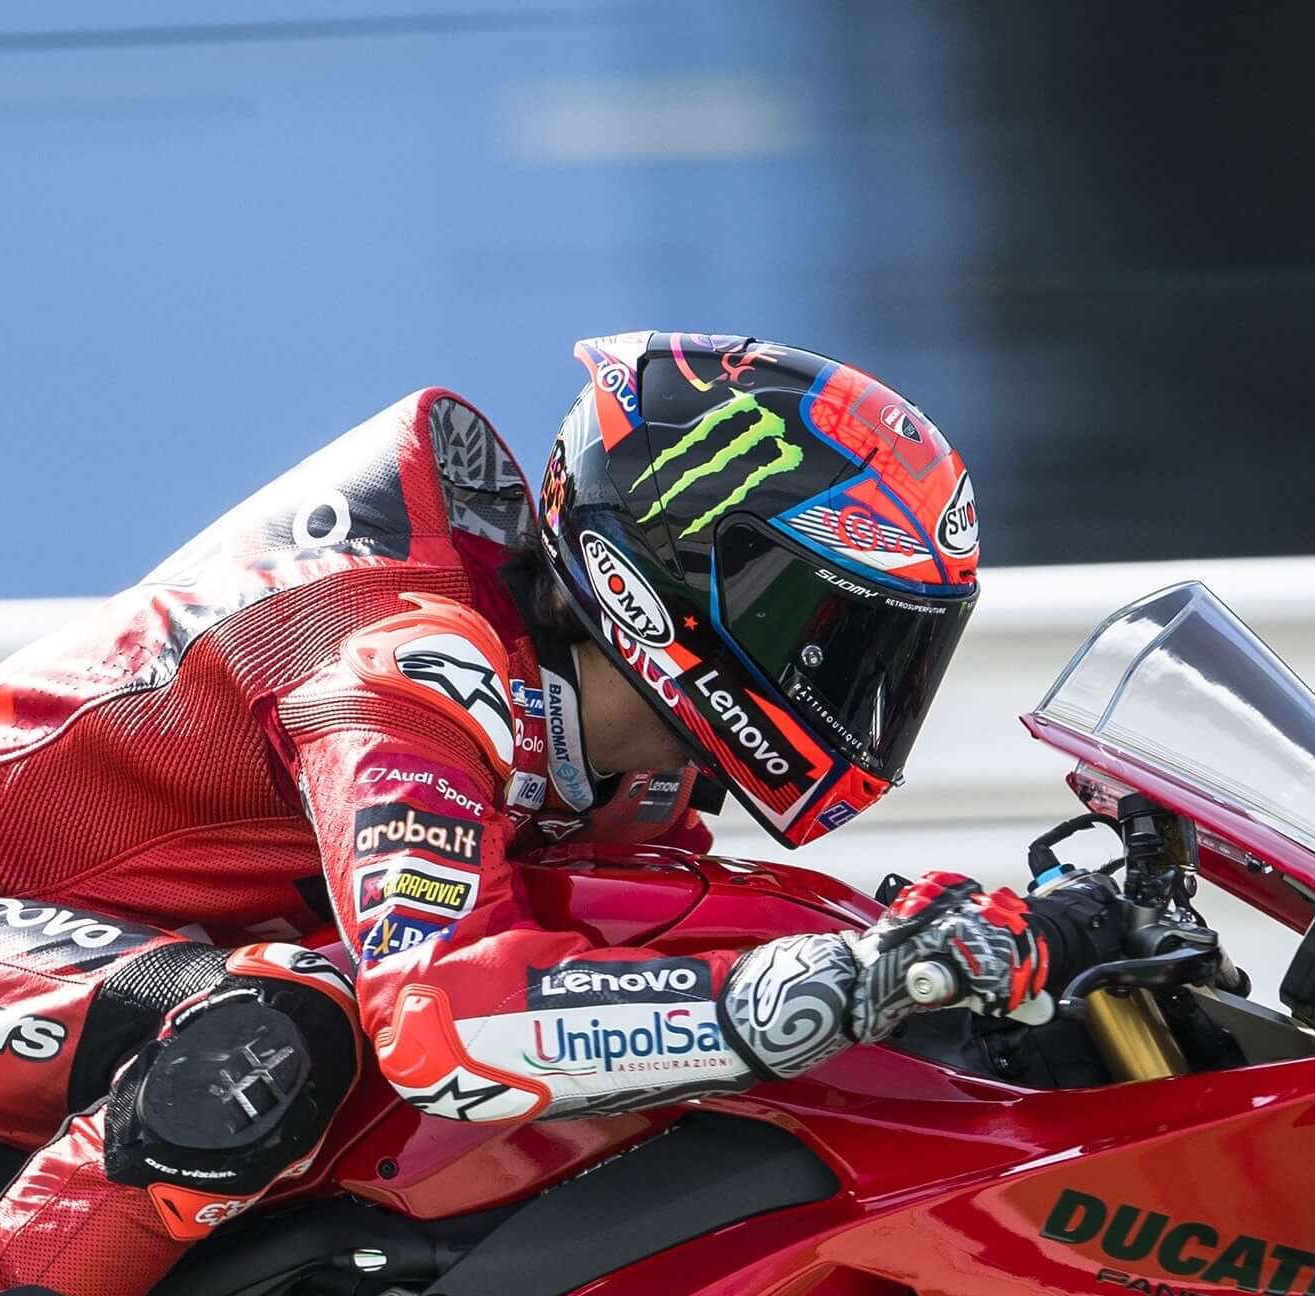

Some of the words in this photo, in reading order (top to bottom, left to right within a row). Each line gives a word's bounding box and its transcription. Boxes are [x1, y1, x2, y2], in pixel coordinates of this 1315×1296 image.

[947, 499, 977, 536] SUO
[589, 540, 660, 637] SUOMY
[814, 568, 879, 599] SUOMY
[885, 597, 947, 615] RETROSUPERFUTURE
[549, 683, 570, 762] BANCOMAT
[694, 669, 789, 775] Lenovo
[386, 769, 433, 785] Audi
[435, 778, 484, 816] Sport
[356, 810, 476, 858] aruba.it
[542, 969, 697, 996] Lenovo
[534, 1009, 729, 1072] UnipolSa
[618, 1057, 733, 1073] ASSICURAZIONI
